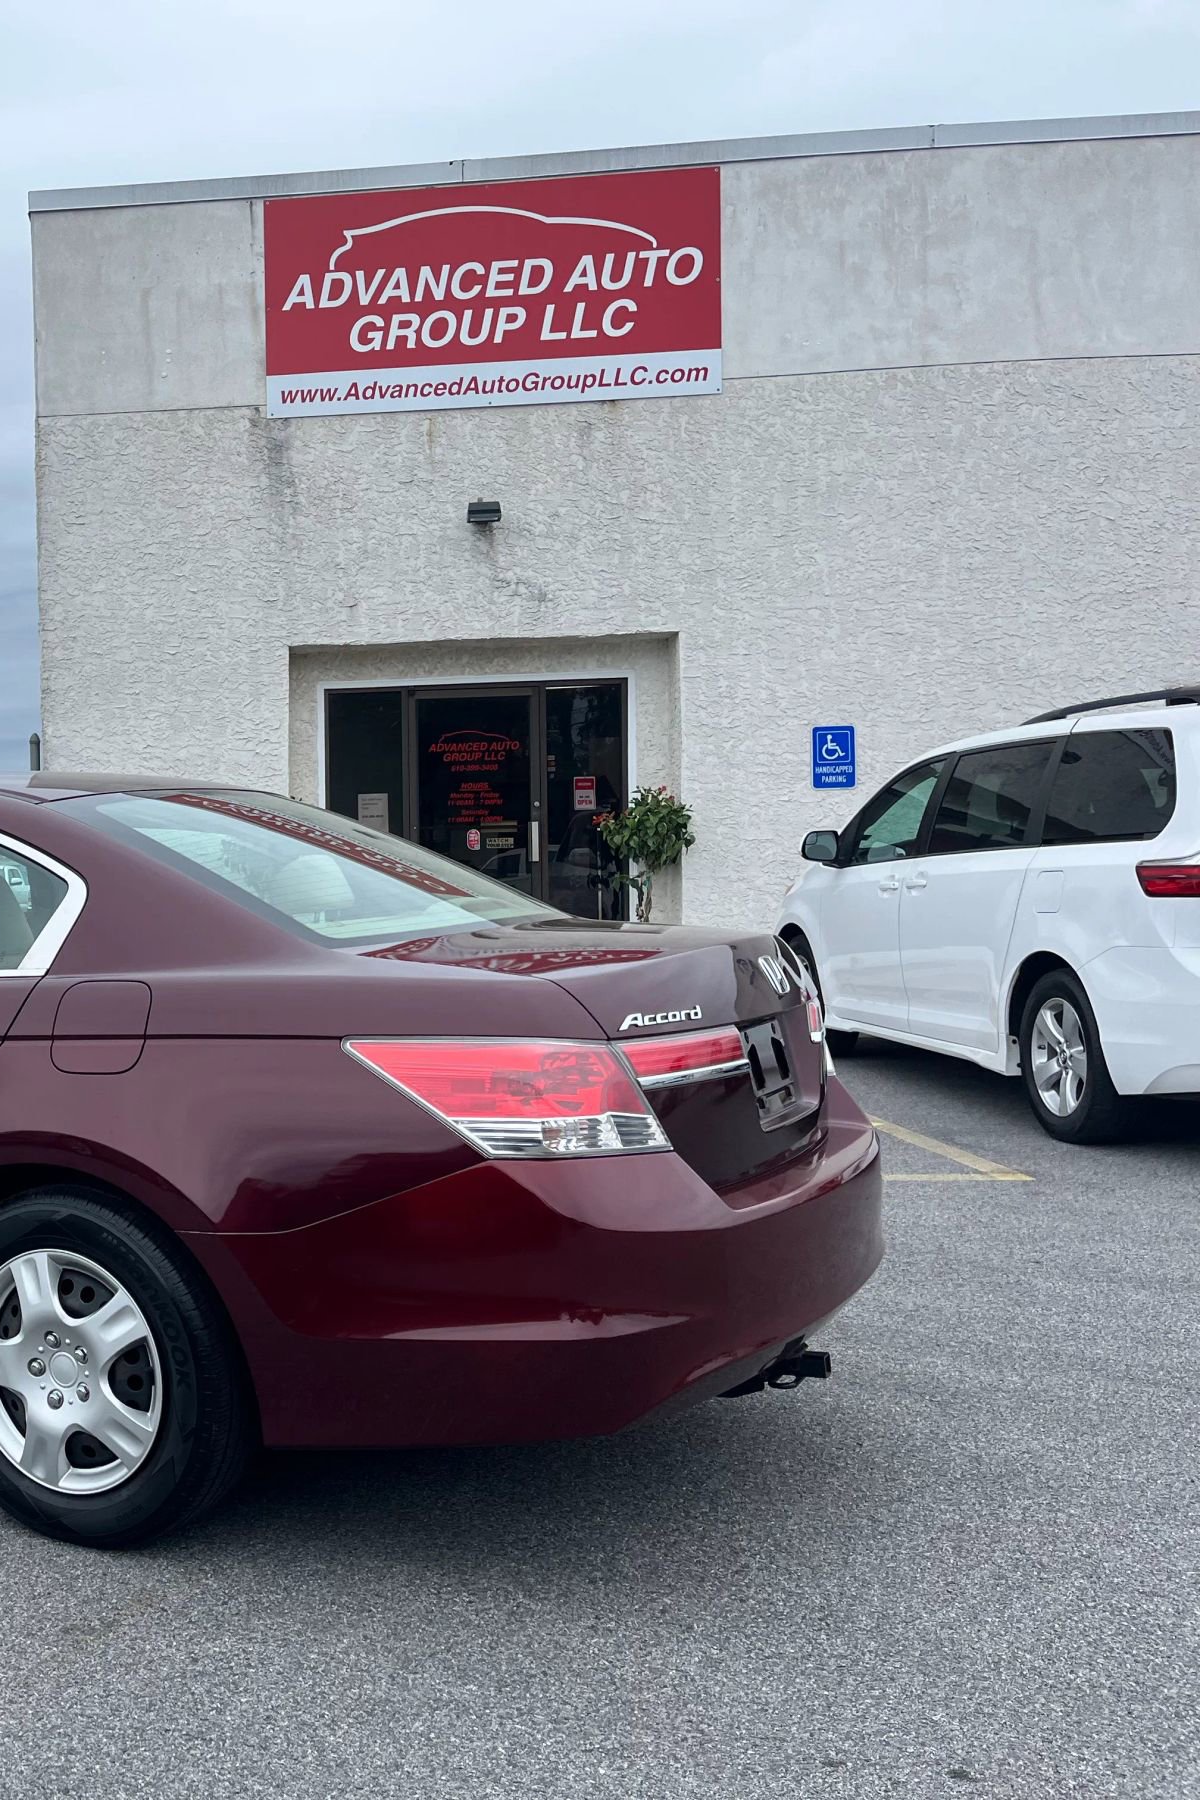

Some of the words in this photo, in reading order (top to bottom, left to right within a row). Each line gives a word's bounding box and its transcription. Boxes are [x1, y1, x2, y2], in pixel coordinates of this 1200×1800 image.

[282, 258, 554, 311] ADVANCED
[563, 246, 704, 293] AUTO
[348, 306, 526, 352] GROUP
[540, 299, 638, 341] LLC
[280, 365, 709, 404] www.AdvancedAutoGroupLLC.com
[428, 742, 488, 752] ADVANCED
[489, 741, 520, 751] AUTO
[442, 752, 482, 762] GROUP
[484, 751, 506, 761] LLC
[815, 766, 853, 774] HANDICAPPED
[821, 775, 847, 784] PARKING
[460, 782, 489, 790] HOURS
[449, 792, 474, 800] Monday
[618, 1005, 702, 1031] Accord
